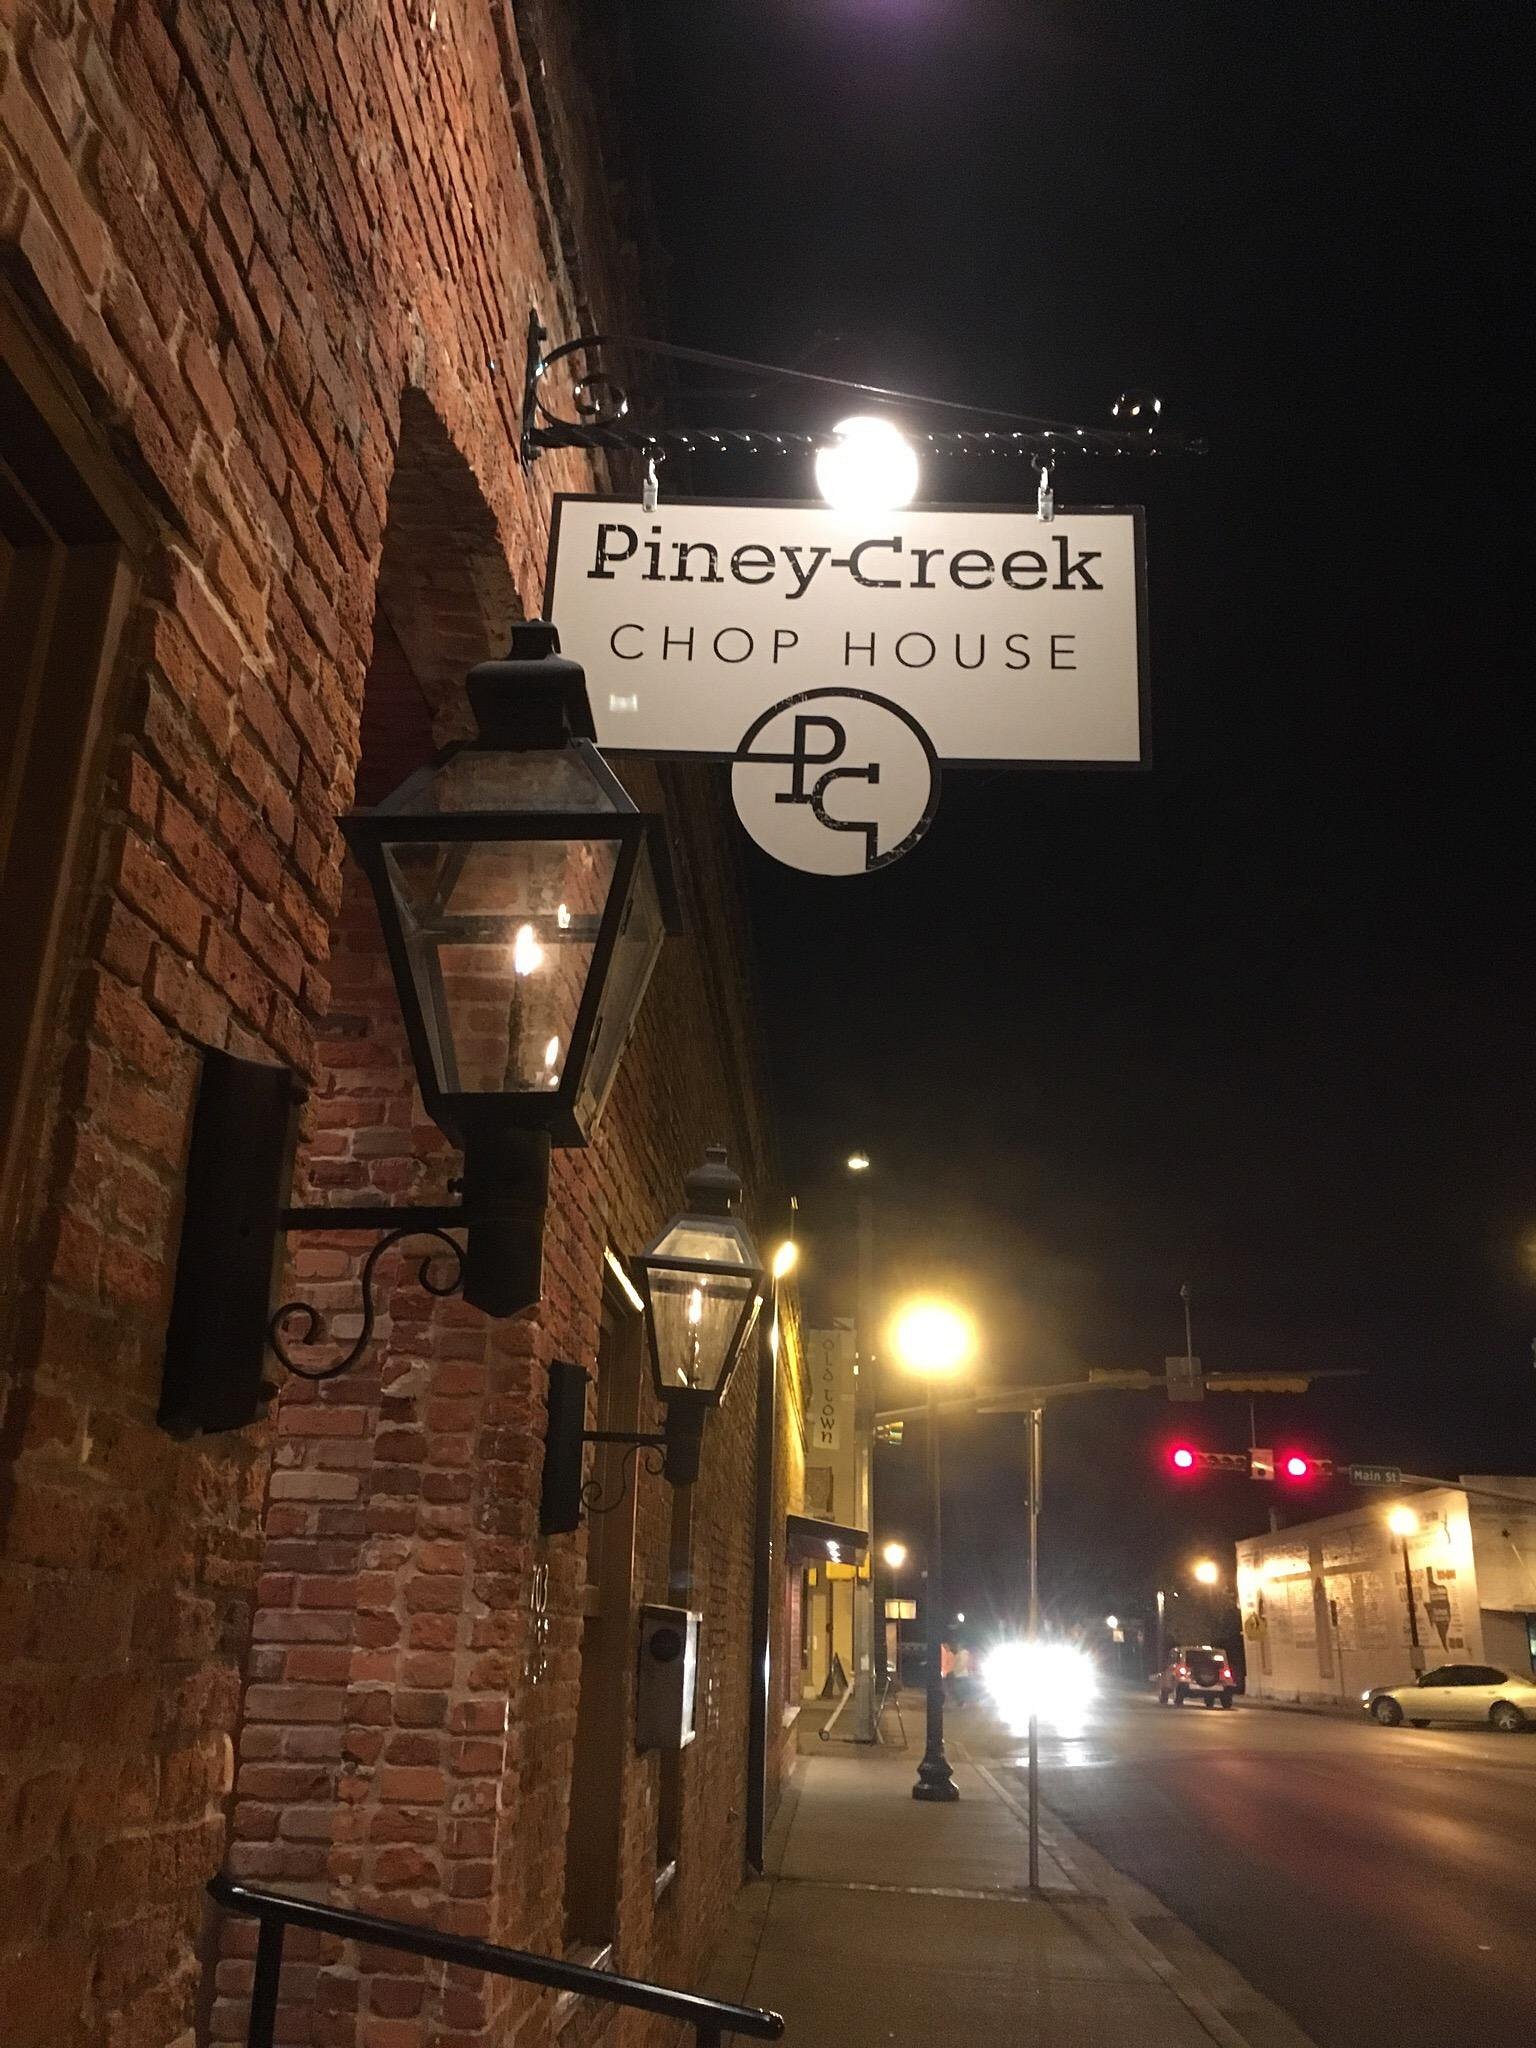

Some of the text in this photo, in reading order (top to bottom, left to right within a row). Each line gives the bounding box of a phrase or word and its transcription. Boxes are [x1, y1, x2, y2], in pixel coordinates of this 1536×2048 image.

[609, 623, 1078, 671] CHOP HOUSE
[1353, 1469, 1396, 1483] Main St
